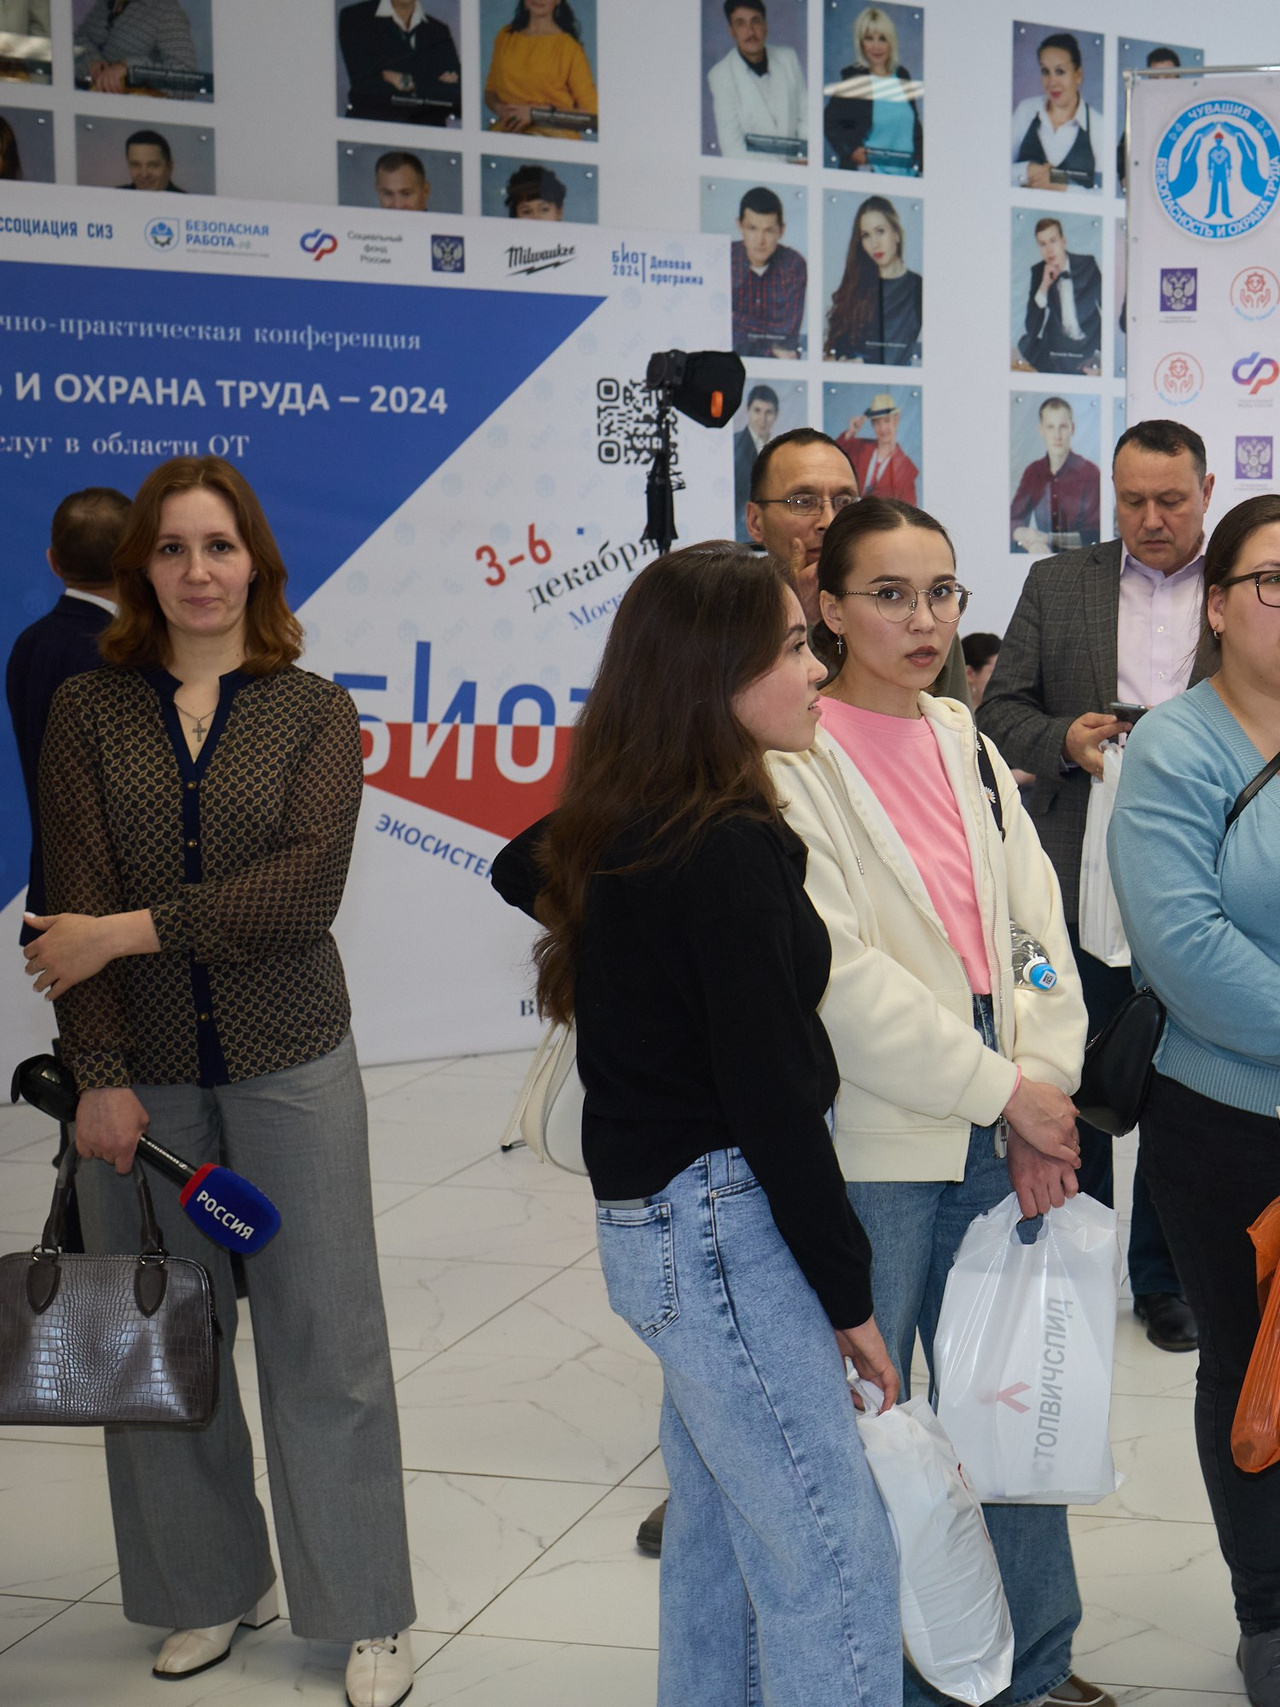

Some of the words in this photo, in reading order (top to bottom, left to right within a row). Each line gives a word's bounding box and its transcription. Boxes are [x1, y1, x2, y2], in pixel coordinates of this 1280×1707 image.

[1187, 102, 1252, 120] ЧУВАШИЯ
[1156, 156, 1215, 237] БЕЗОПАСНОСТЬ
[1216, 224, 1226, 238] И
[1227, 199, 1272, 236] ОХРАНА
[87, 222, 113, 240] СИЗ
[185, 219, 270, 237] БЕЗОПАСНАЯ
[504, 243, 577, 269] Milwaukee
[611, 241, 647, 284] БИОТ
[612, 264, 640, 277] 2024
[650, 255, 692, 270] Деловая
[650, 272, 704, 288] программа
[254, 324, 422, 353] конференция
[15, 371, 41, 402] И
[54, 372, 207, 408] ОХРАНА
[216, 379, 331, 417] ТРУДА
[369, 385, 449, 416] 2024
[92, 430, 199, 458] области
[208, 433, 251, 459] ОТ
[333, 640, 591, 785] БИО
[374, 812, 493, 880] ЭКОСИСТЕ
[196, 1190, 255, 1240] РОССИЯ
